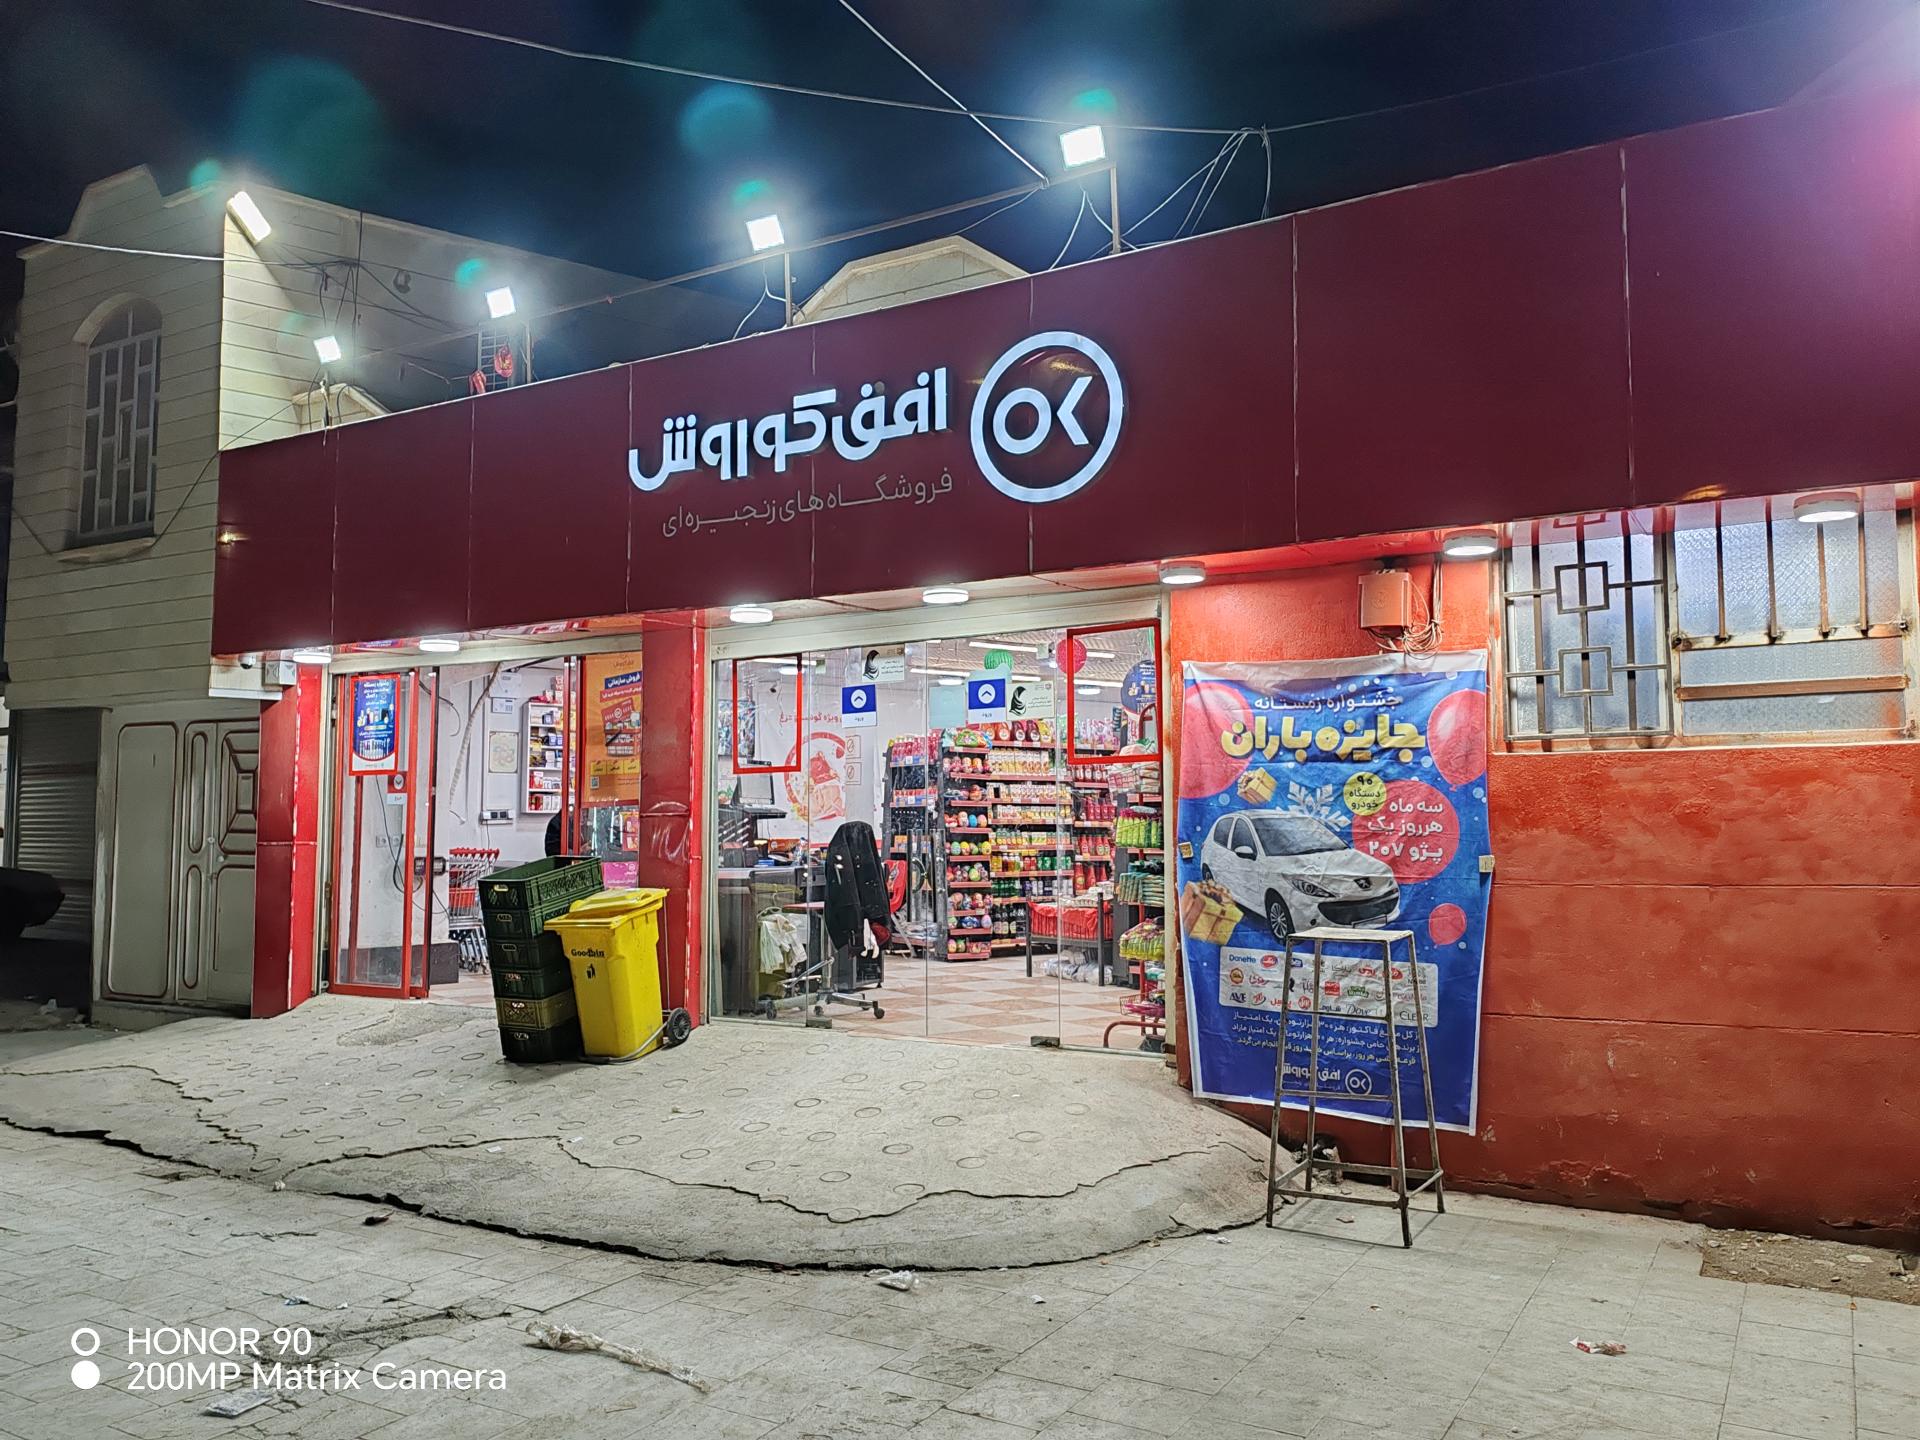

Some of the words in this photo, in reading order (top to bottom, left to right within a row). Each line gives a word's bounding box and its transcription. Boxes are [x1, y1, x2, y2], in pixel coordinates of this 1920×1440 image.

[831, 366, 948, 461] افق
[628, 388, 837, 492] کوروش
[1254, 695, 1322, 713] زمستانه
[1327, 690, 1402, 712] جشنواره
[1221, 715, 1313, 762] باران
[1315, 713, 1426, 763] جایزه
[1349, 788, 1381, 798] دستگاه
[1351, 802, 1379, 810] خودرو
[1389, 798, 1414, 813] ماه
[1416, 800, 1443, 813] سه
[1367, 815, 1395, 836] یک
[1368, 841, 1404, 857] ۲۰۷
[1409, 841, 1443, 865] پژو
[1399, 1010, 1429, 1022] CLER
